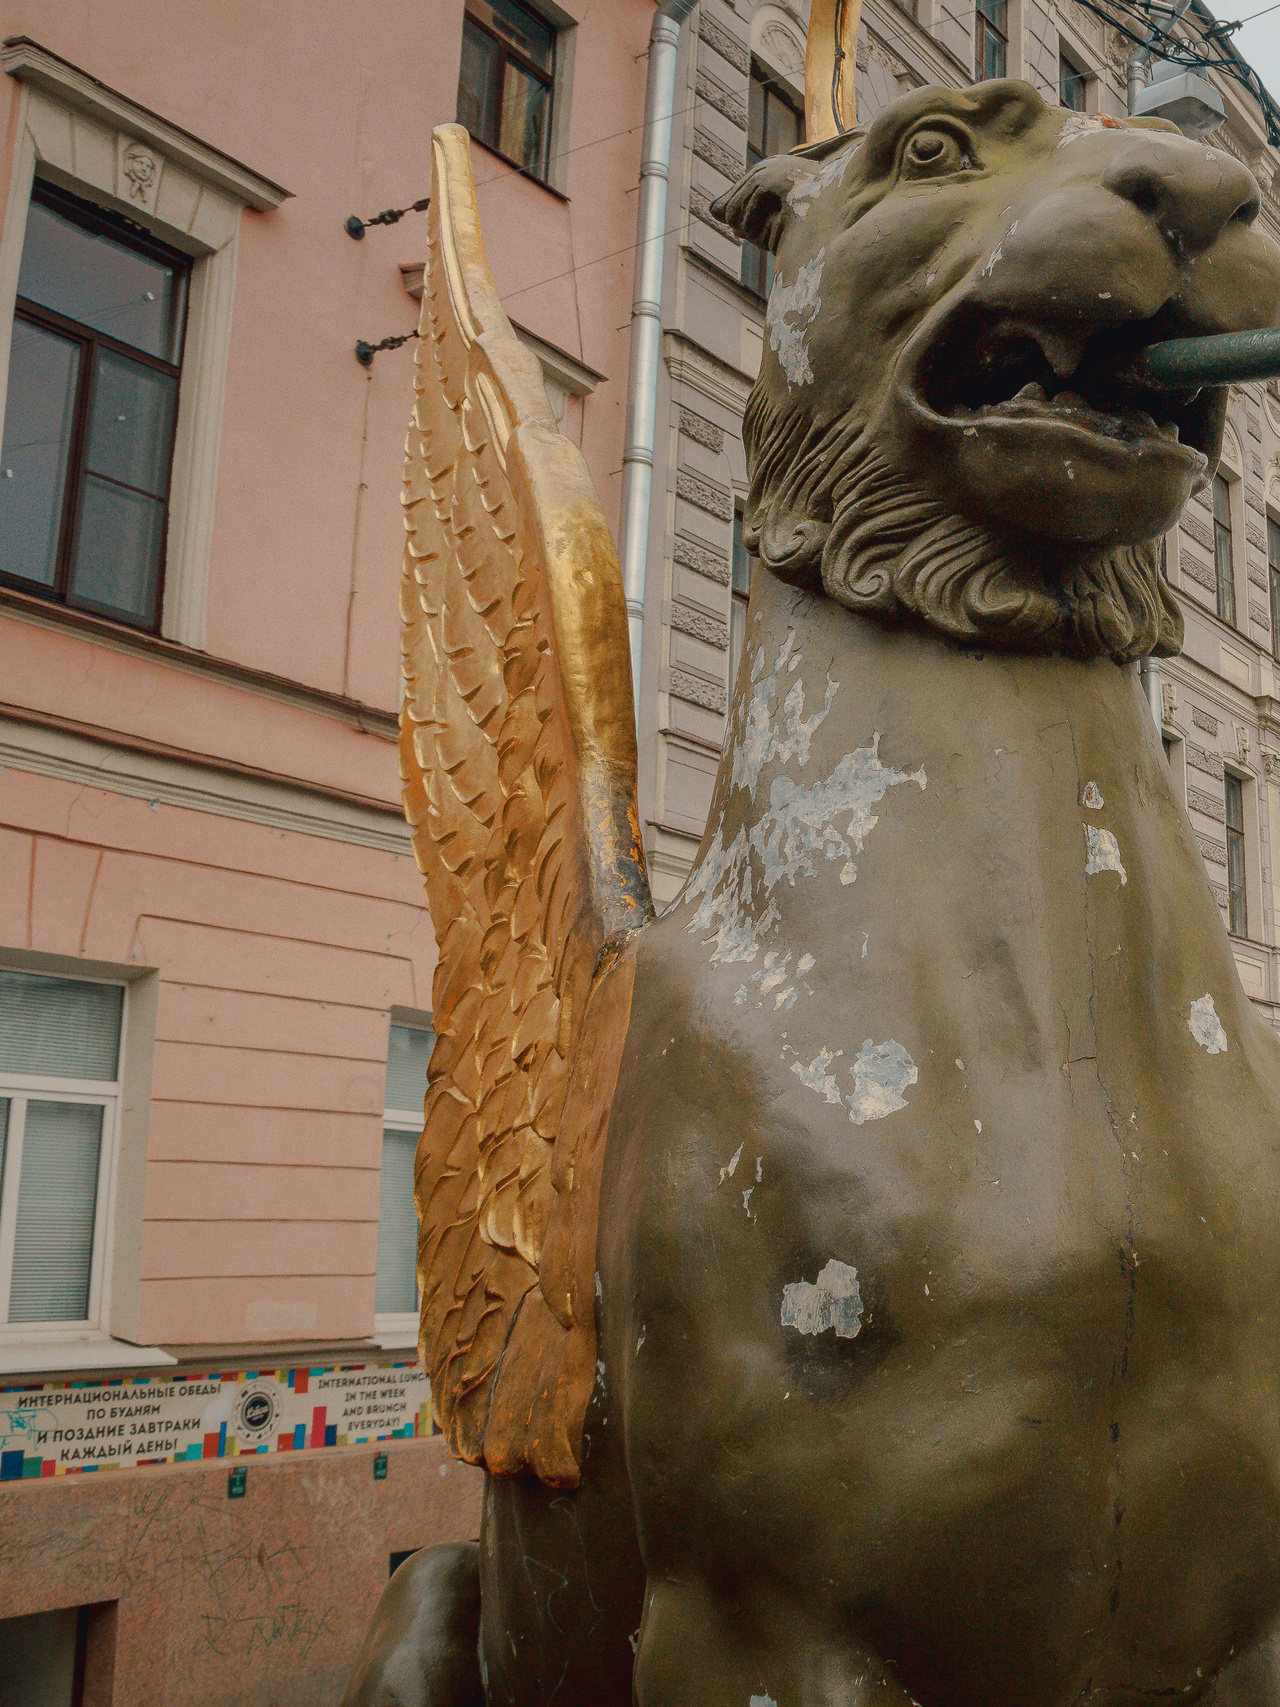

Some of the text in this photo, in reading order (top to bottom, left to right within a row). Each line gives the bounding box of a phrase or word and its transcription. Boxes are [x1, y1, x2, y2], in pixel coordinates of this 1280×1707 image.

[318, 1374, 397, 1389] INTERNATIONAL
[18, 1384, 222, 1408] ИНТЕРНАЦИОНАЛЬНЫЕ ОБЕДЫ
[345, 1388, 406, 1402] IN THE WEEK
[87, 1404, 161, 1420] ПО БУДНЯМ
[342, 1402, 407, 1417] AND BRUNCH
[37, 1418, 201, 1443] И ПОЗДНИЕ ЗАВТРАКИ
[348, 1417, 400, 1431] EVERYDAY!
[60, 1439, 133, 1461] КАЖДЫЙ
